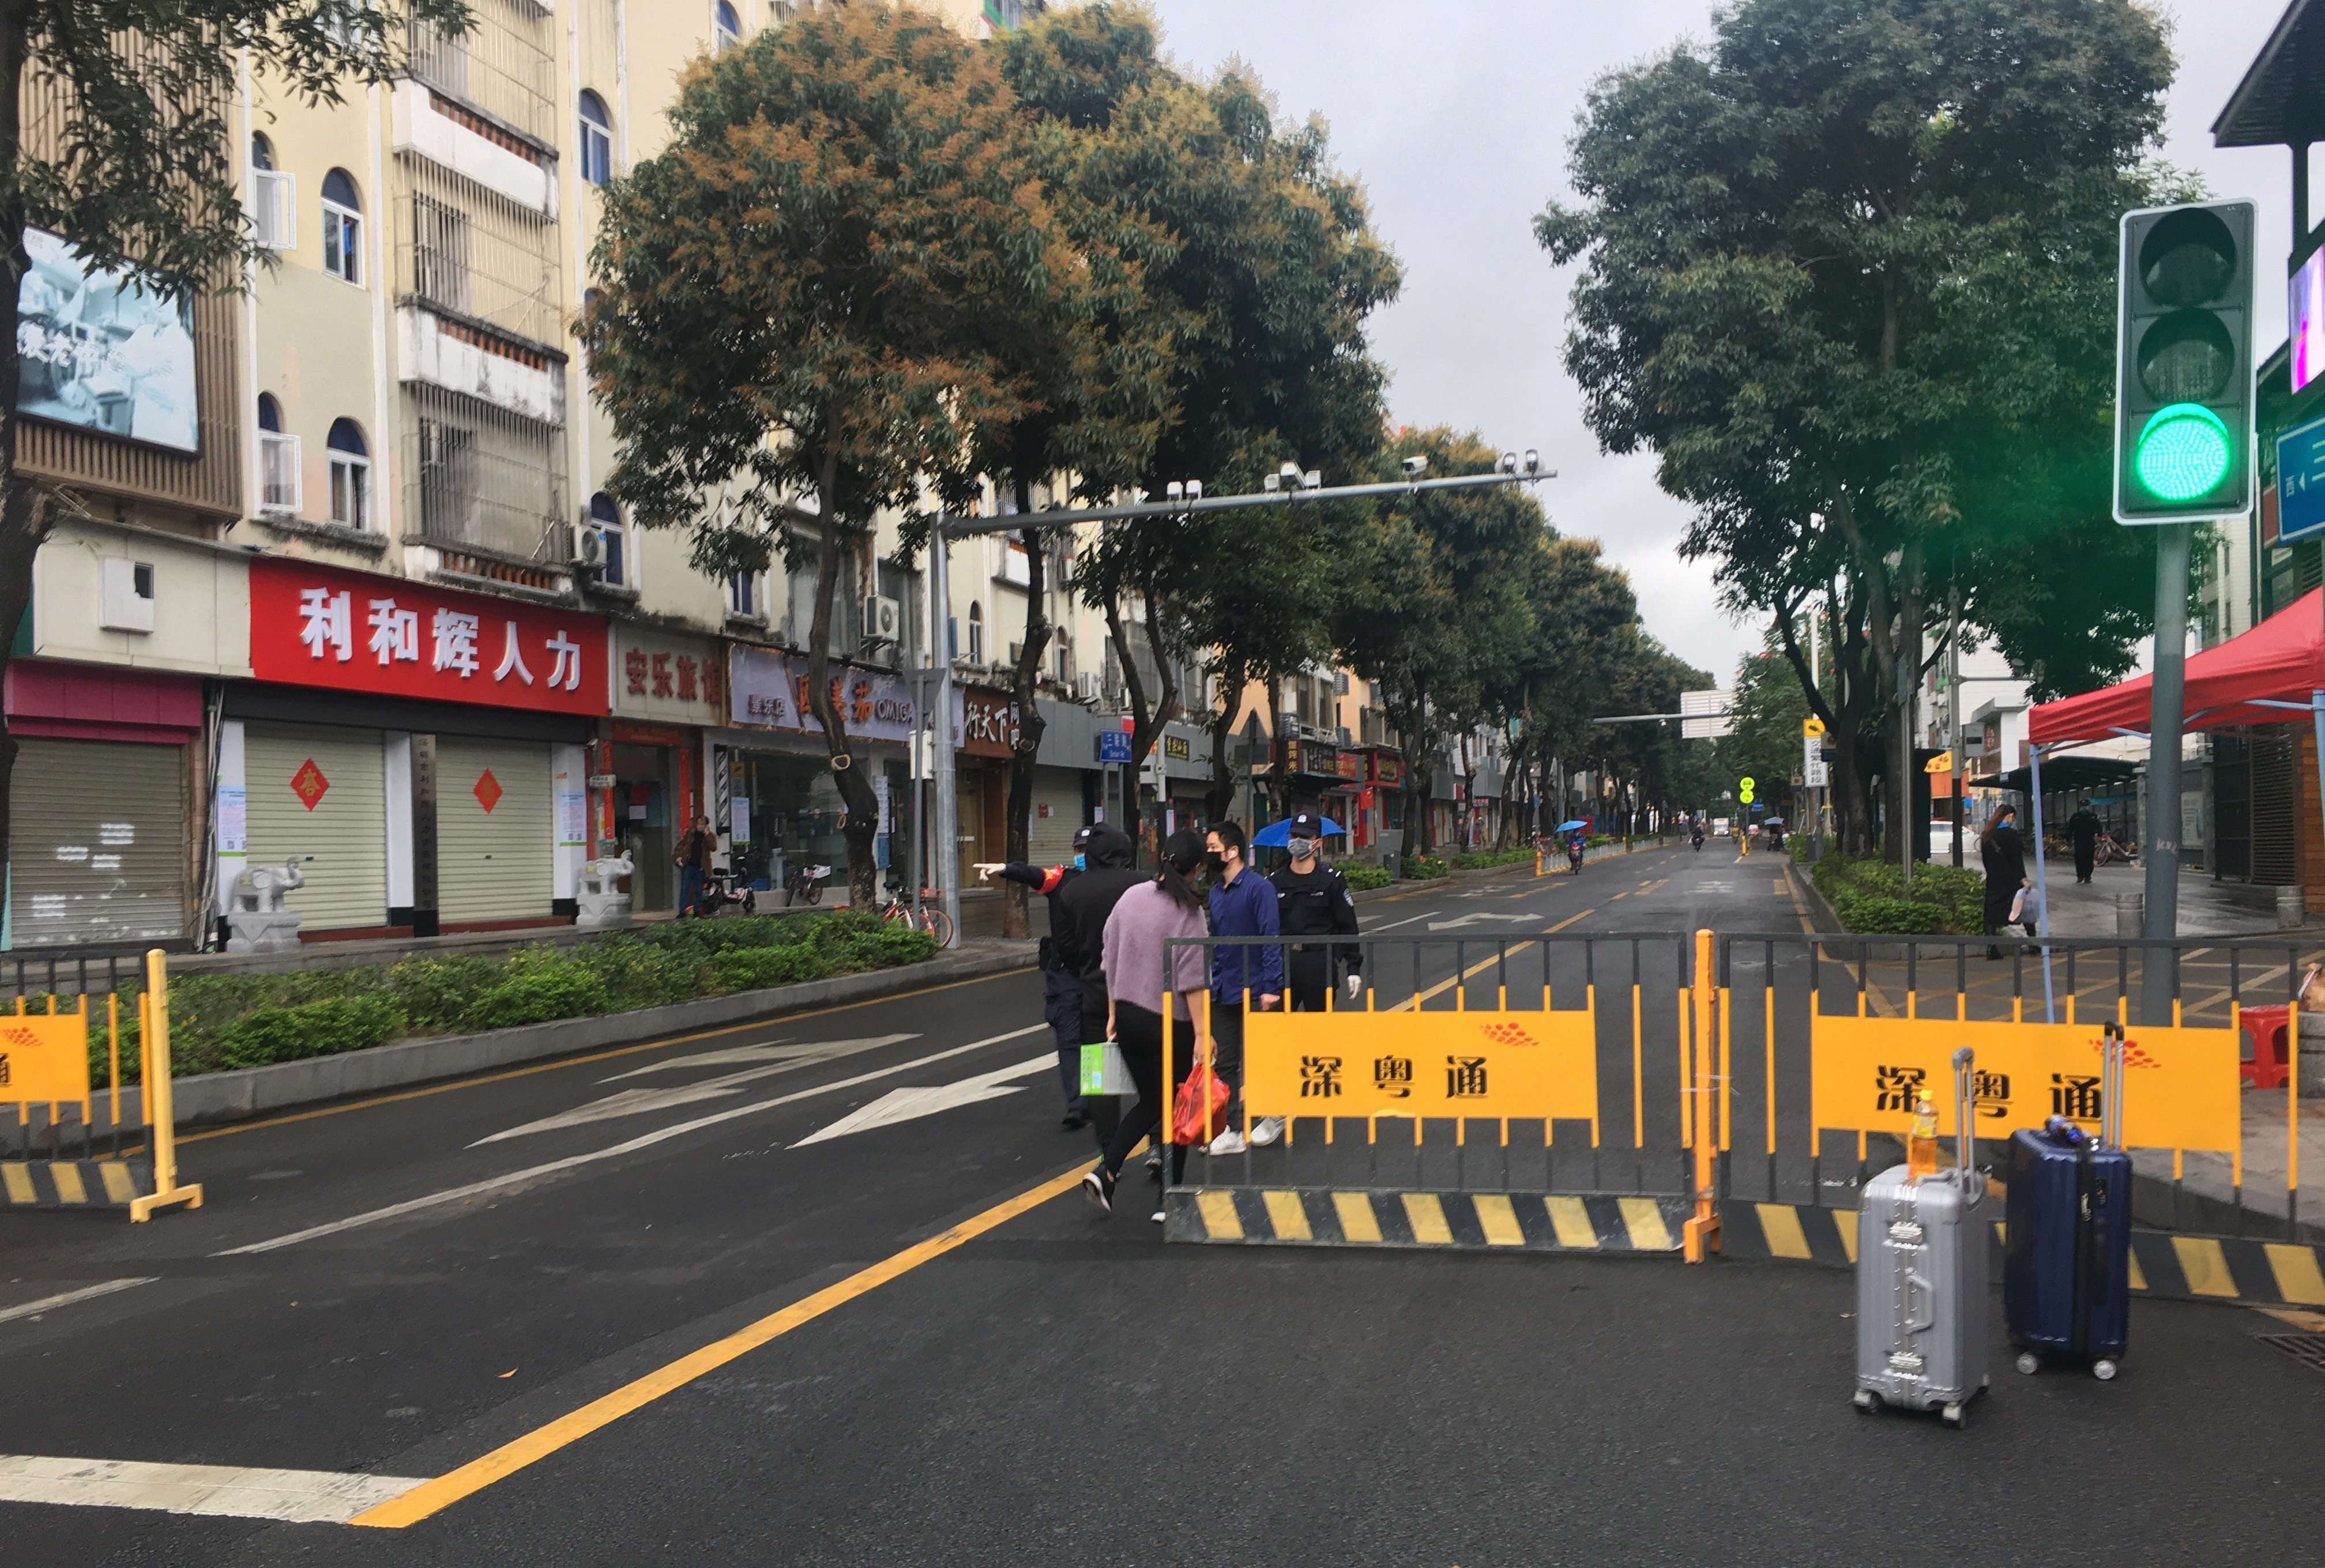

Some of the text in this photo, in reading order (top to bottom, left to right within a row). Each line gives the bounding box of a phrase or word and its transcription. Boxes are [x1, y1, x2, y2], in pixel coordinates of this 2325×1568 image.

[299, 587, 581, 692] 利和辉人力
[625, 647, 722, 703] 安乐旅馆
[1299, 1054, 1489, 1099] 深粤通
[1876, 1064, 2104, 1124] 深粤通
